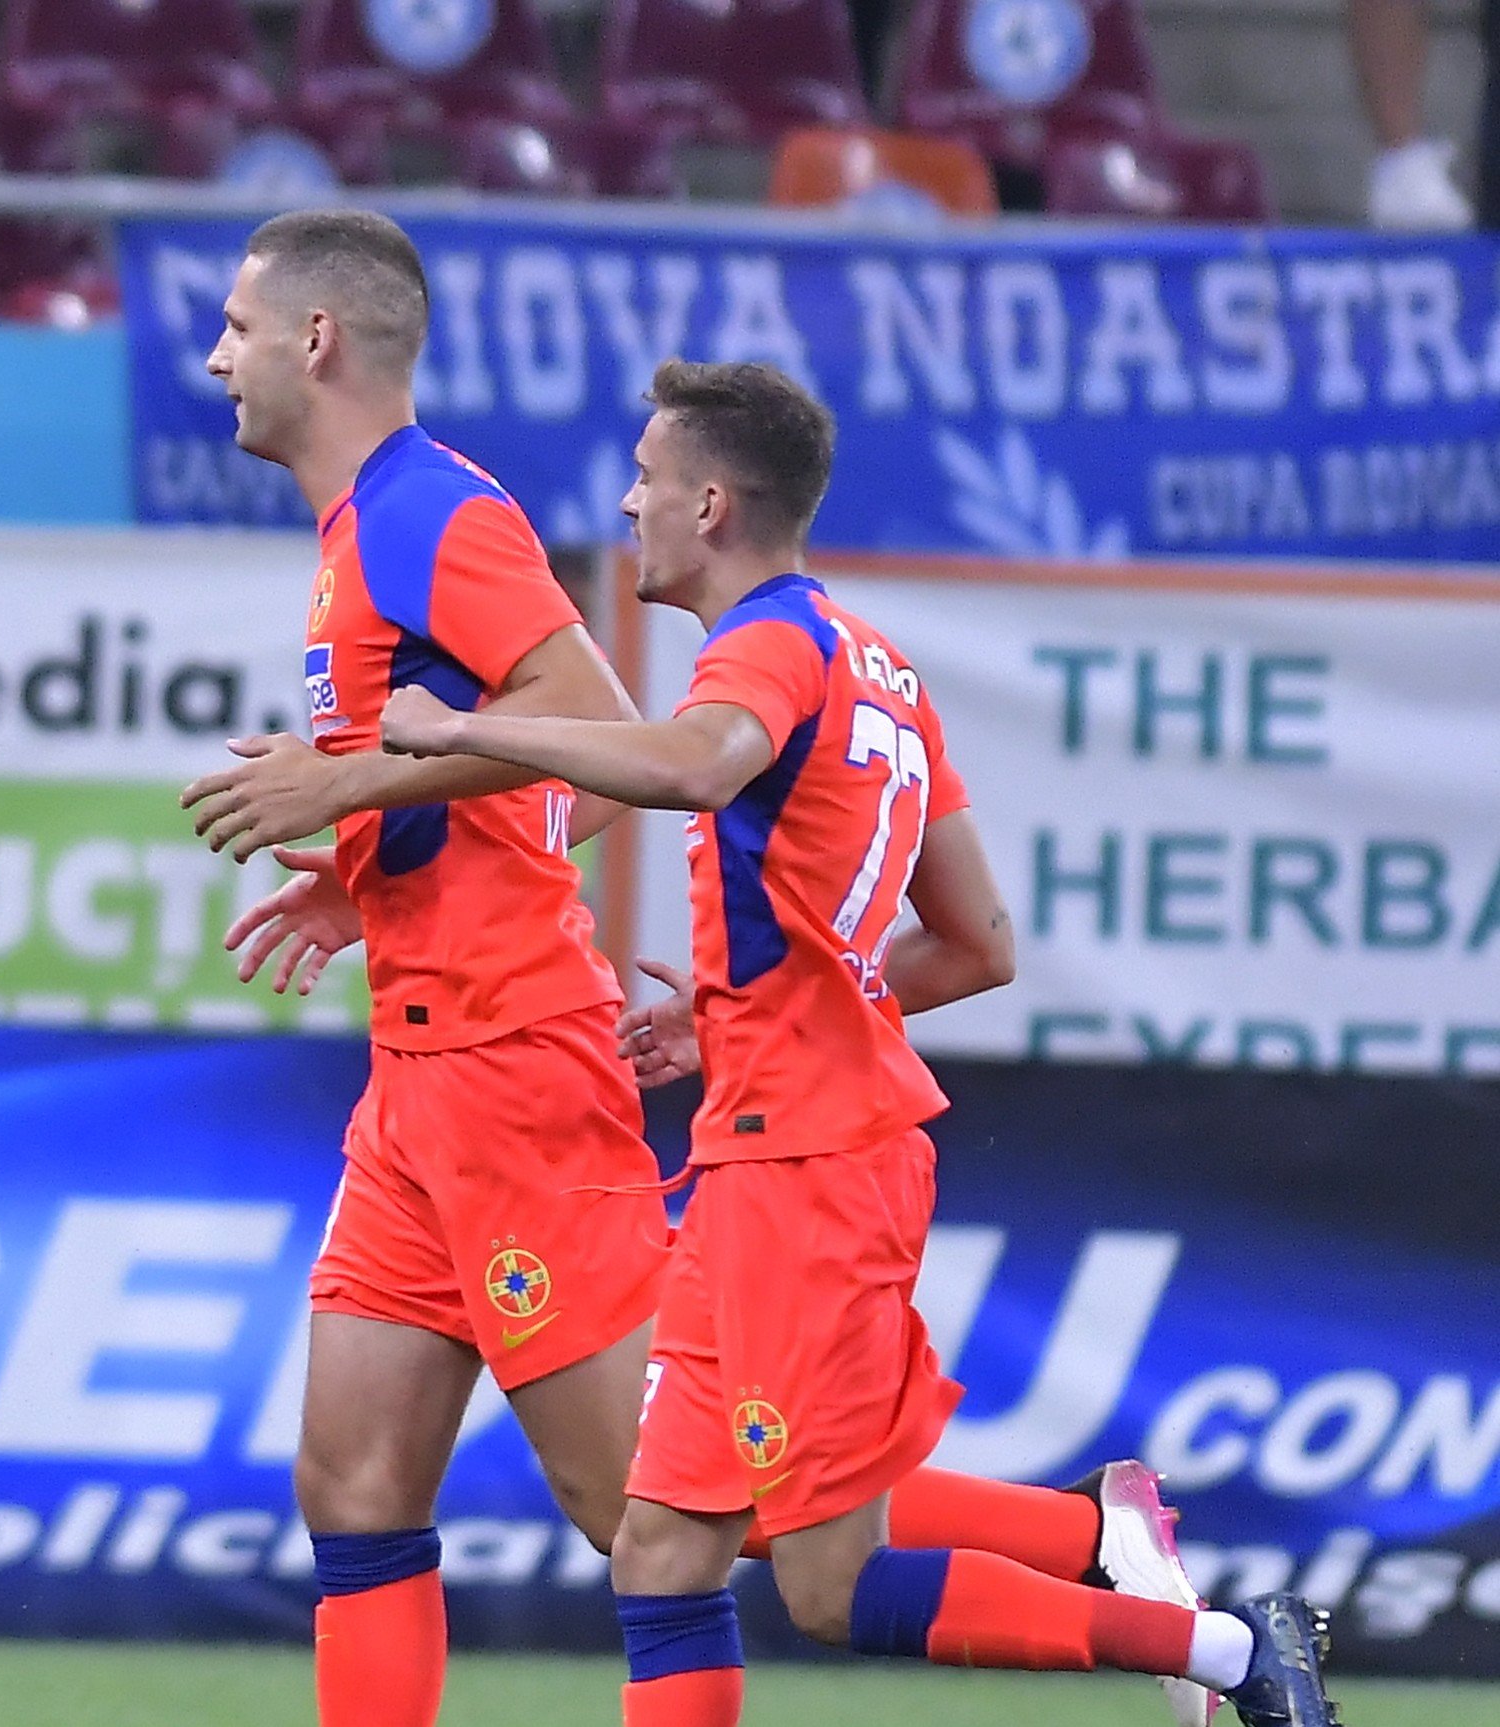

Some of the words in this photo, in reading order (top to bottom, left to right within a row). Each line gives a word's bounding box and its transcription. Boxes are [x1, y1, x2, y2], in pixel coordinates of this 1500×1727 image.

[850, 255, 1500, 418] NOASTR
[1030, 645, 1332, 766] THE
[1030, 828, 1500, 955] HERB
